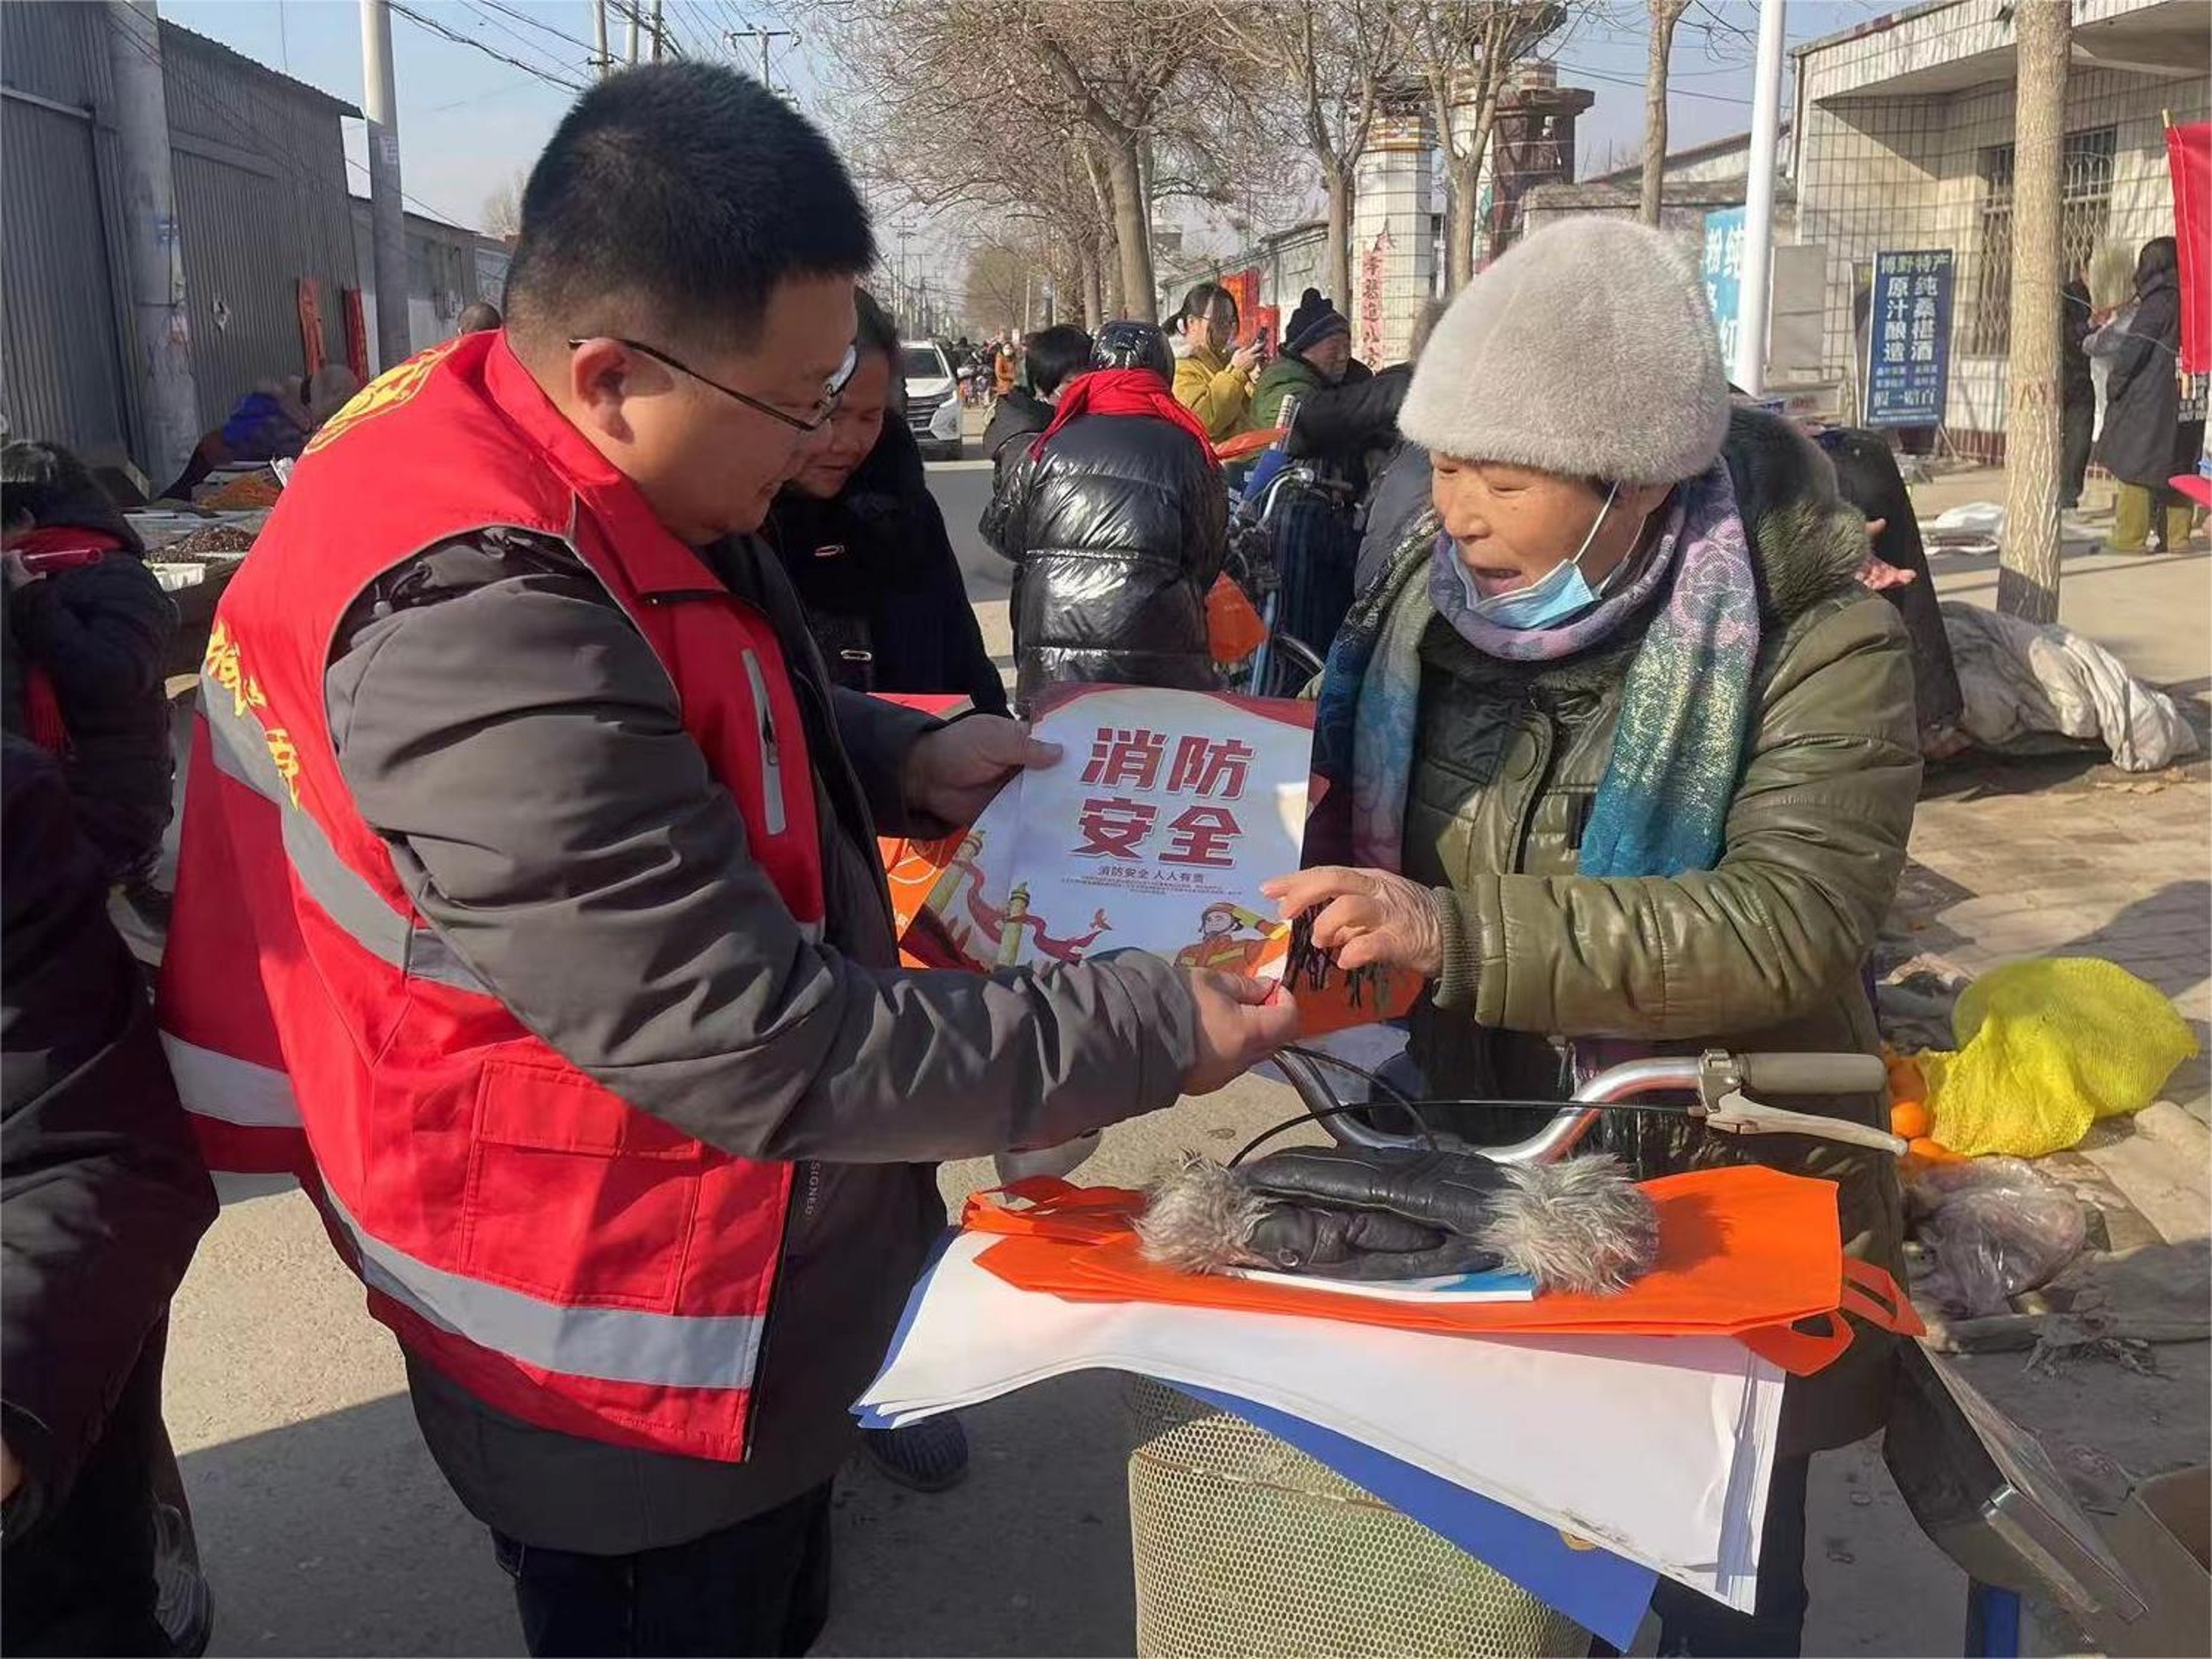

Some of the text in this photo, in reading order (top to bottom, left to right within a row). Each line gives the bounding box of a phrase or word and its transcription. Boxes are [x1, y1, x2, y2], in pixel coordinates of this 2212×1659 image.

[1882, 276, 1910, 362] 原汁酿造
[1079, 726, 1256, 800] 消防
[1069, 796, 1244, 868] 安全
